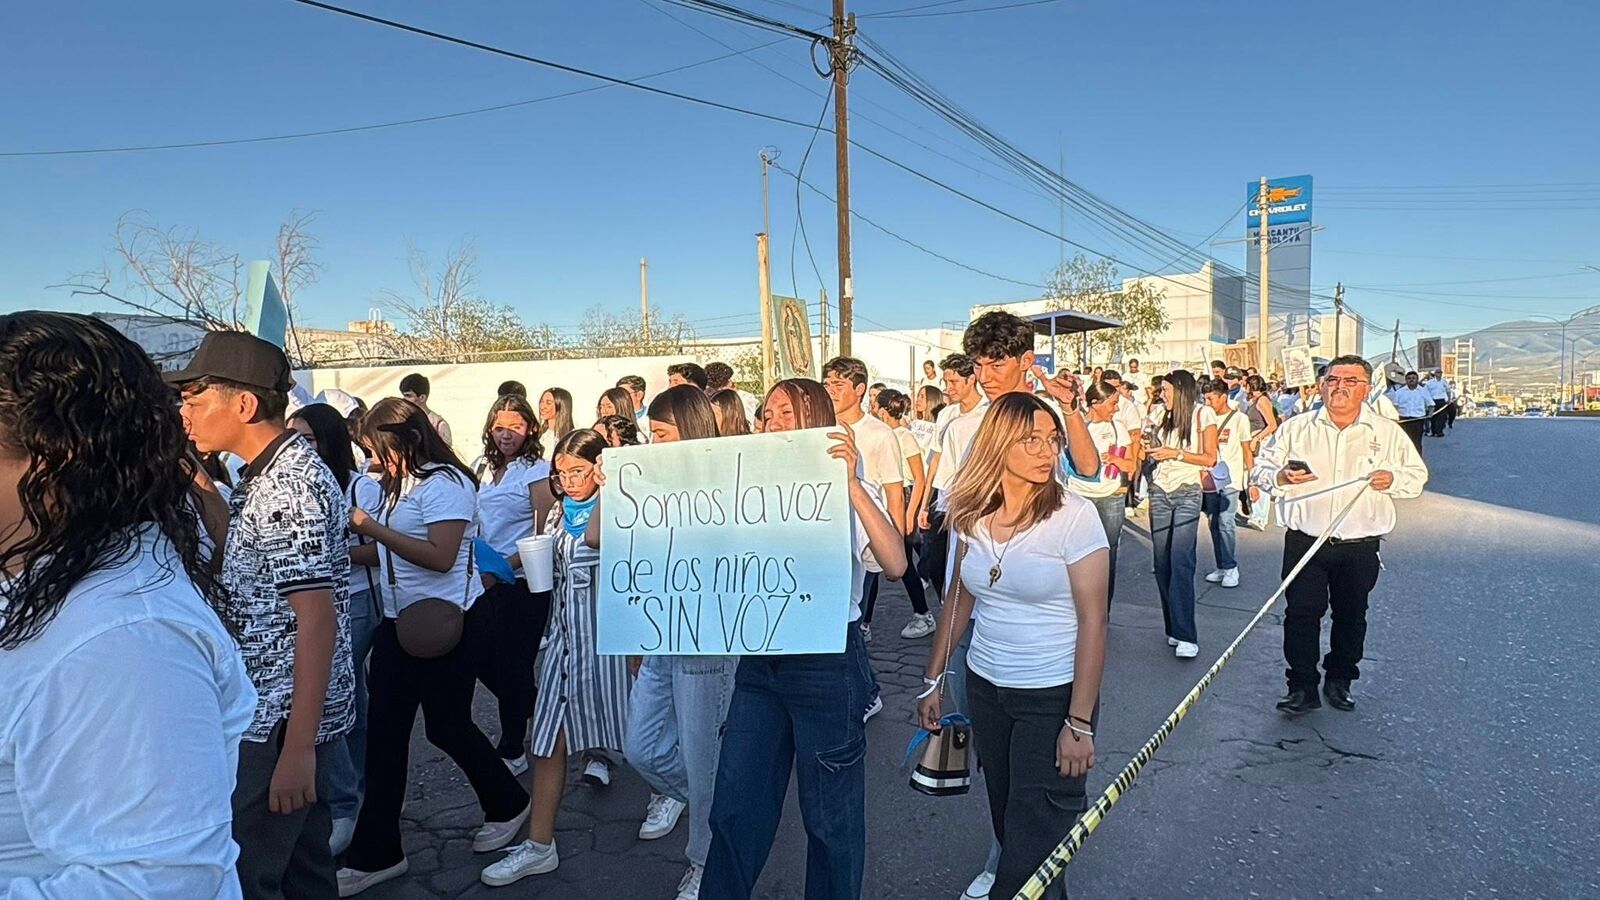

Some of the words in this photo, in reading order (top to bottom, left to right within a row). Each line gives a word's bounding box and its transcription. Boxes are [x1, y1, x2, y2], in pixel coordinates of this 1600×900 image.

[1249, 204, 1307, 216] CHVROLET
[1254, 234, 1300, 245] MNCLOVA
[615, 462, 726, 530] Somos
[734, 452, 768, 526] la
[776, 481, 833, 523] voz
[611, 528, 654, 594] de
[663, 526, 702, 594] los
[712, 551, 798, 595] niños
